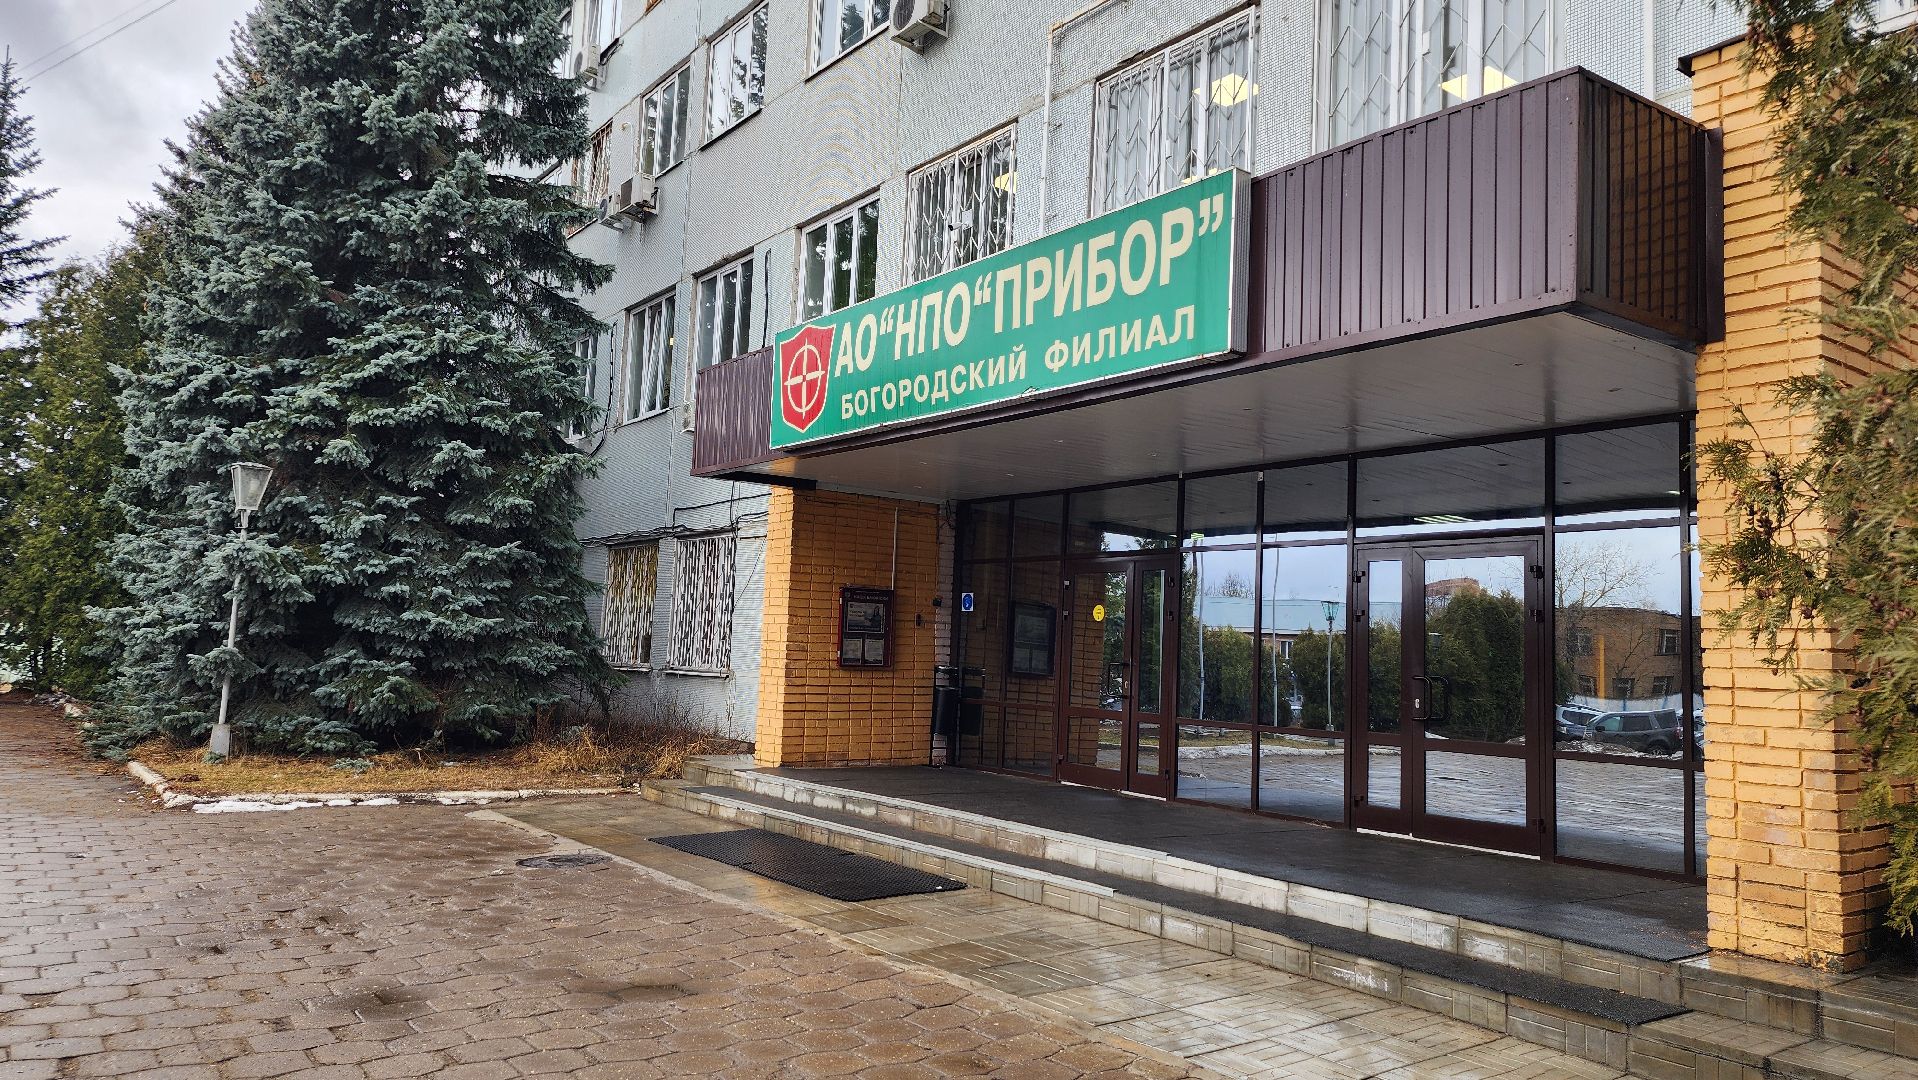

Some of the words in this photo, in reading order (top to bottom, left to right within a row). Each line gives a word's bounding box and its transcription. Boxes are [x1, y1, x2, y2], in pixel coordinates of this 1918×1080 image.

[834, 313, 878, 378] АО
[841, 344, 1027, 420] БОГОРОДСКИЙ
[1044, 304, 1196, 373] ФИЛИАЛ
